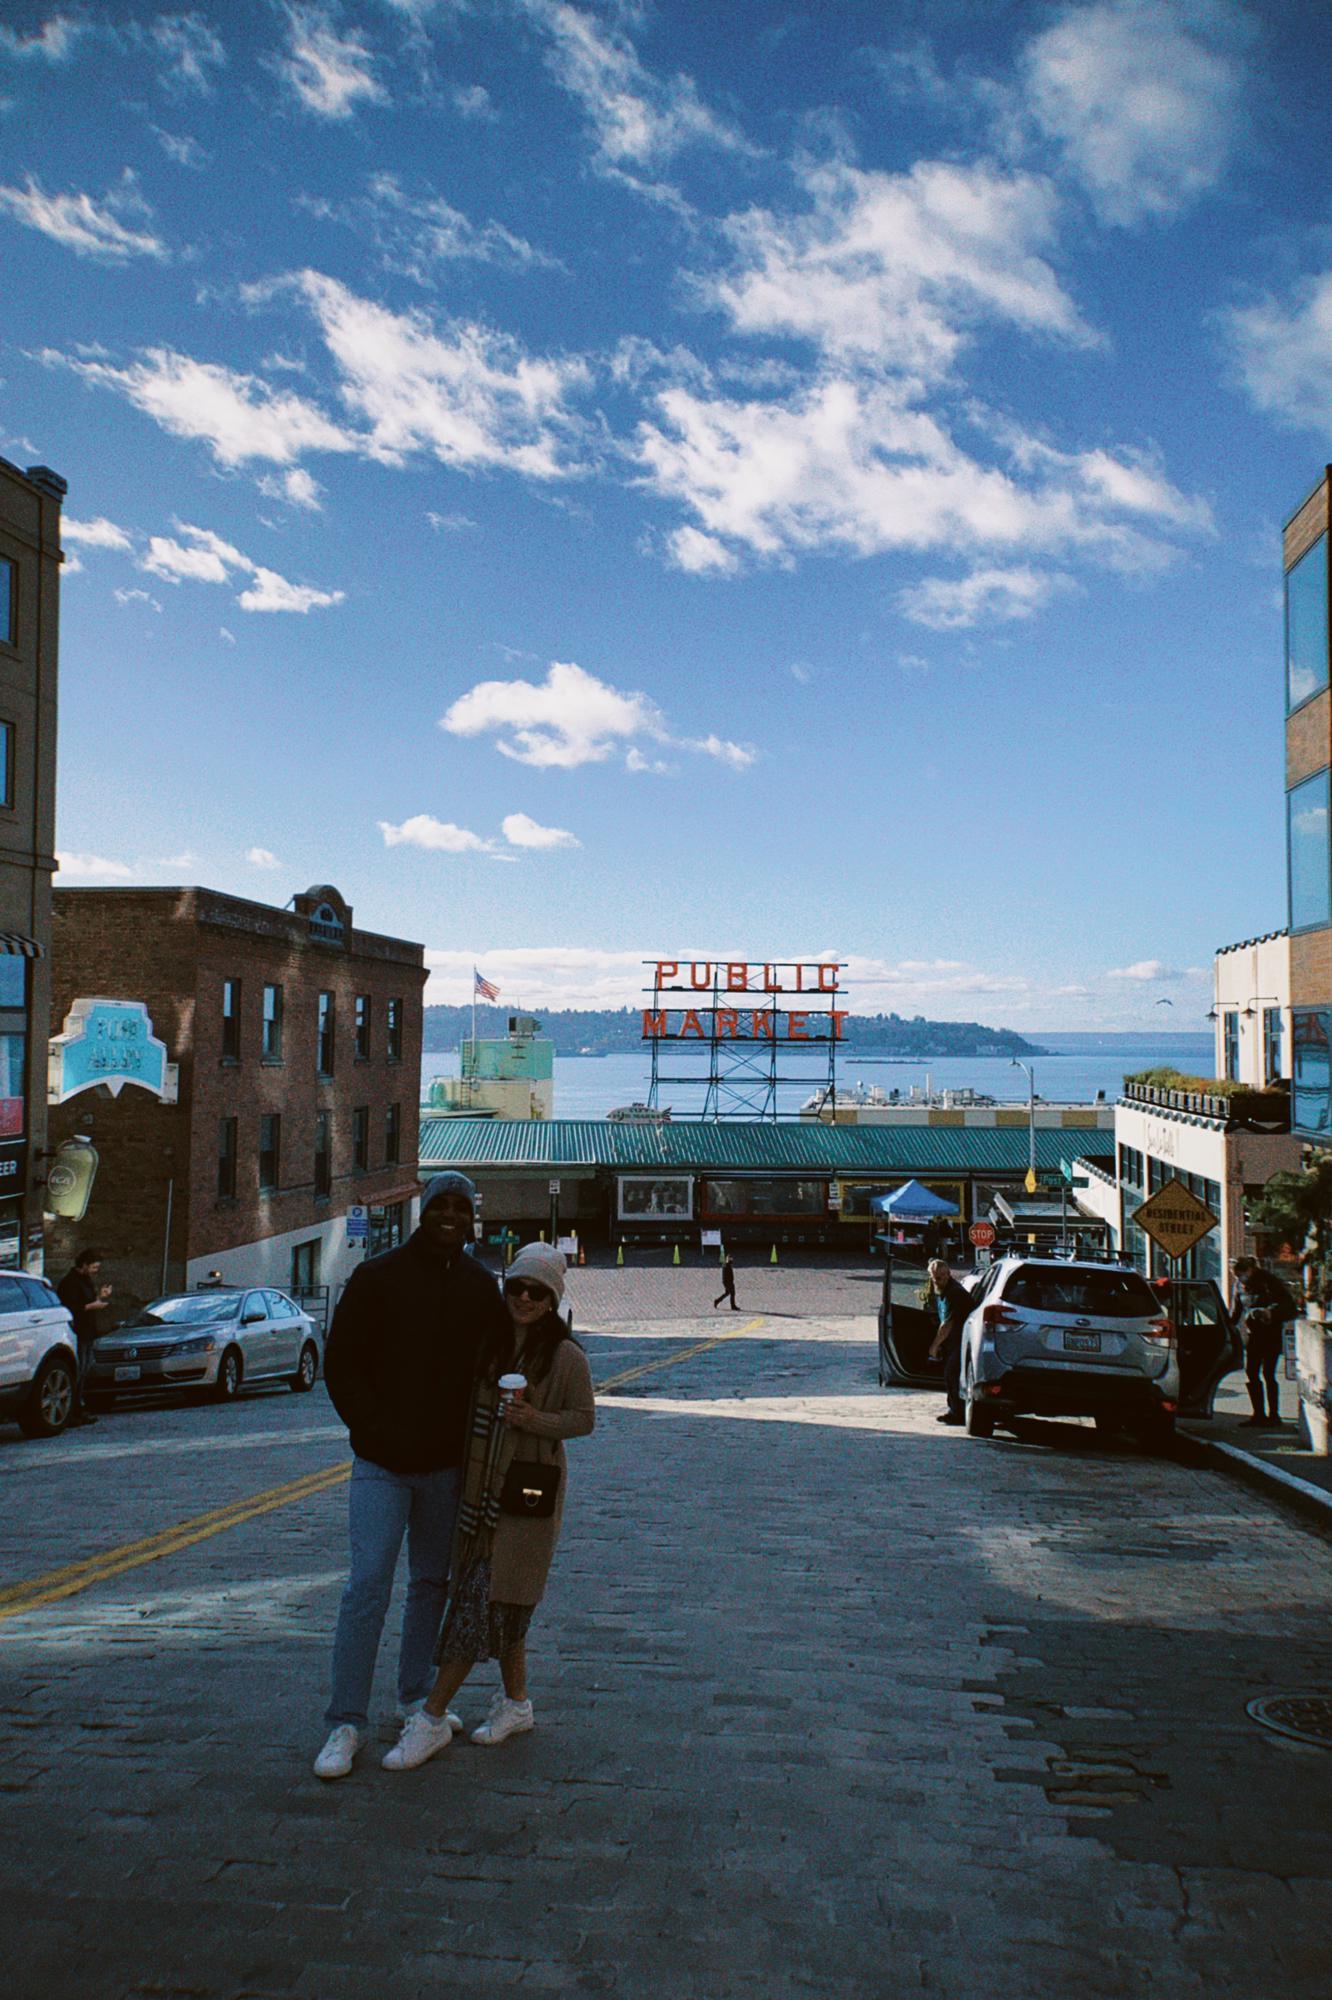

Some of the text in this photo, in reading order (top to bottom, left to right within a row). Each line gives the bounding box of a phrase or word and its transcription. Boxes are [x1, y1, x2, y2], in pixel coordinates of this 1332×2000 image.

[657, 961, 840, 992] PUBLIC
[642, 1009, 849, 1039] MARKET
[1146, 1207, 1206, 1222] RESIDENTIAL
[970, 1229, 993, 1240] STOP
[1158, 1222, 1195, 1234] STREET
